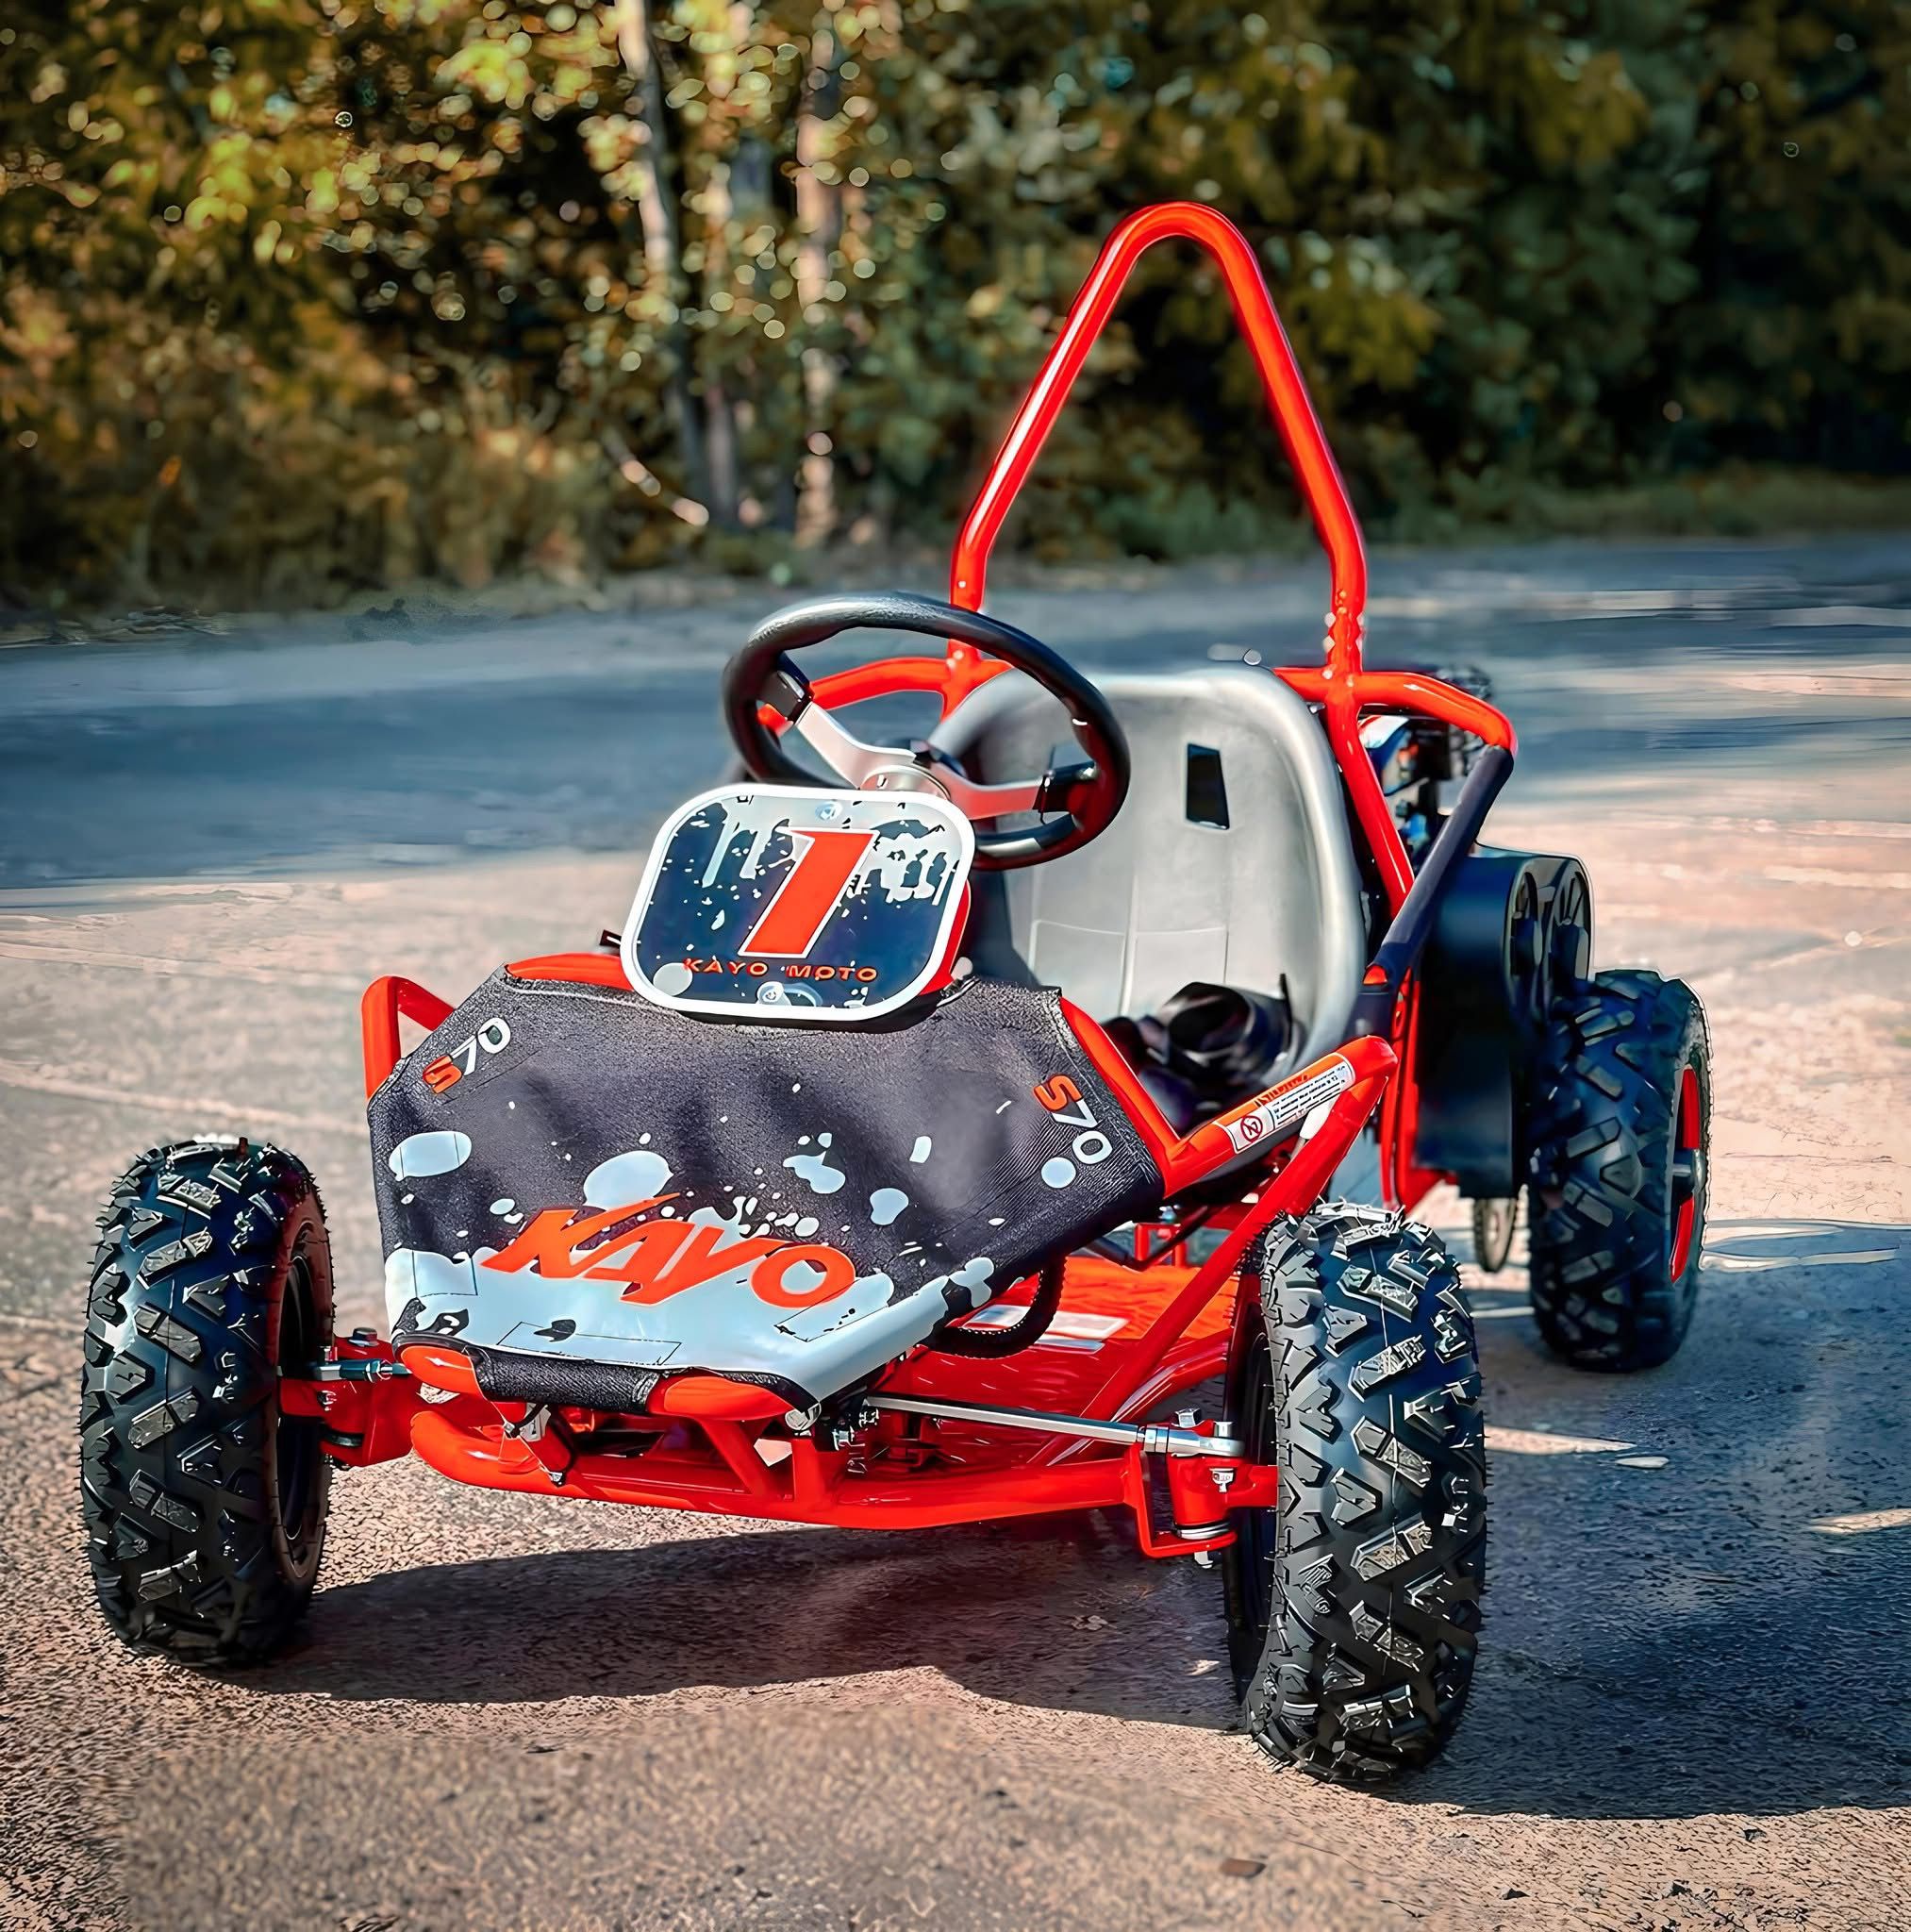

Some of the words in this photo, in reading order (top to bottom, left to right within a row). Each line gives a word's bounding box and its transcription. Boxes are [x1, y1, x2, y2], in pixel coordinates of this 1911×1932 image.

[739, 826, 879, 958] 1
[683, 958, 769, 977] KAYO
[785, 964, 878, 983] MOTO
[422, 1017, 511, 1094] S70
[1033, 1074, 1113, 1165] S70
[480, 1191, 857, 1308] KAYO
